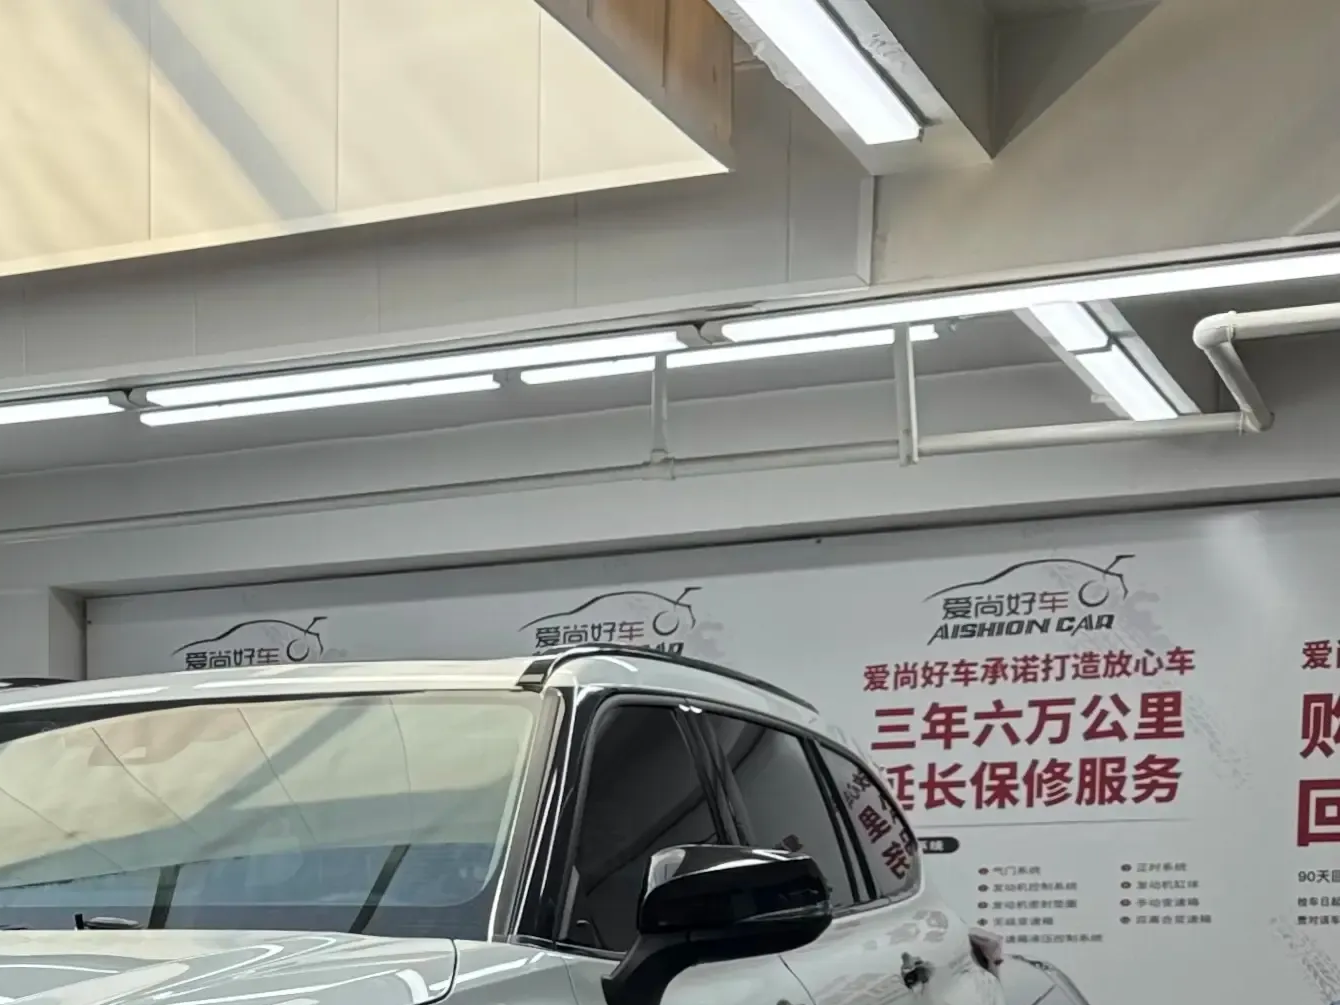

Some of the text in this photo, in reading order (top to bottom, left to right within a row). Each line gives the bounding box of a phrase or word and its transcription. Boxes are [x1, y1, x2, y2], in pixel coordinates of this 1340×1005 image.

[942, 591, 1069, 620] 爱尚好车
[535, 621, 645, 648] 爱尚好车
[927, 614, 1115, 646] AISHION CAR
[185, 648, 279, 669] 爱尚好车
[863, 646, 1196, 692] 爱尚好车承诺打造放心车
[1301, 639, 1340, 669] 爱
[871, 690, 1185, 751] 三年六万公里
